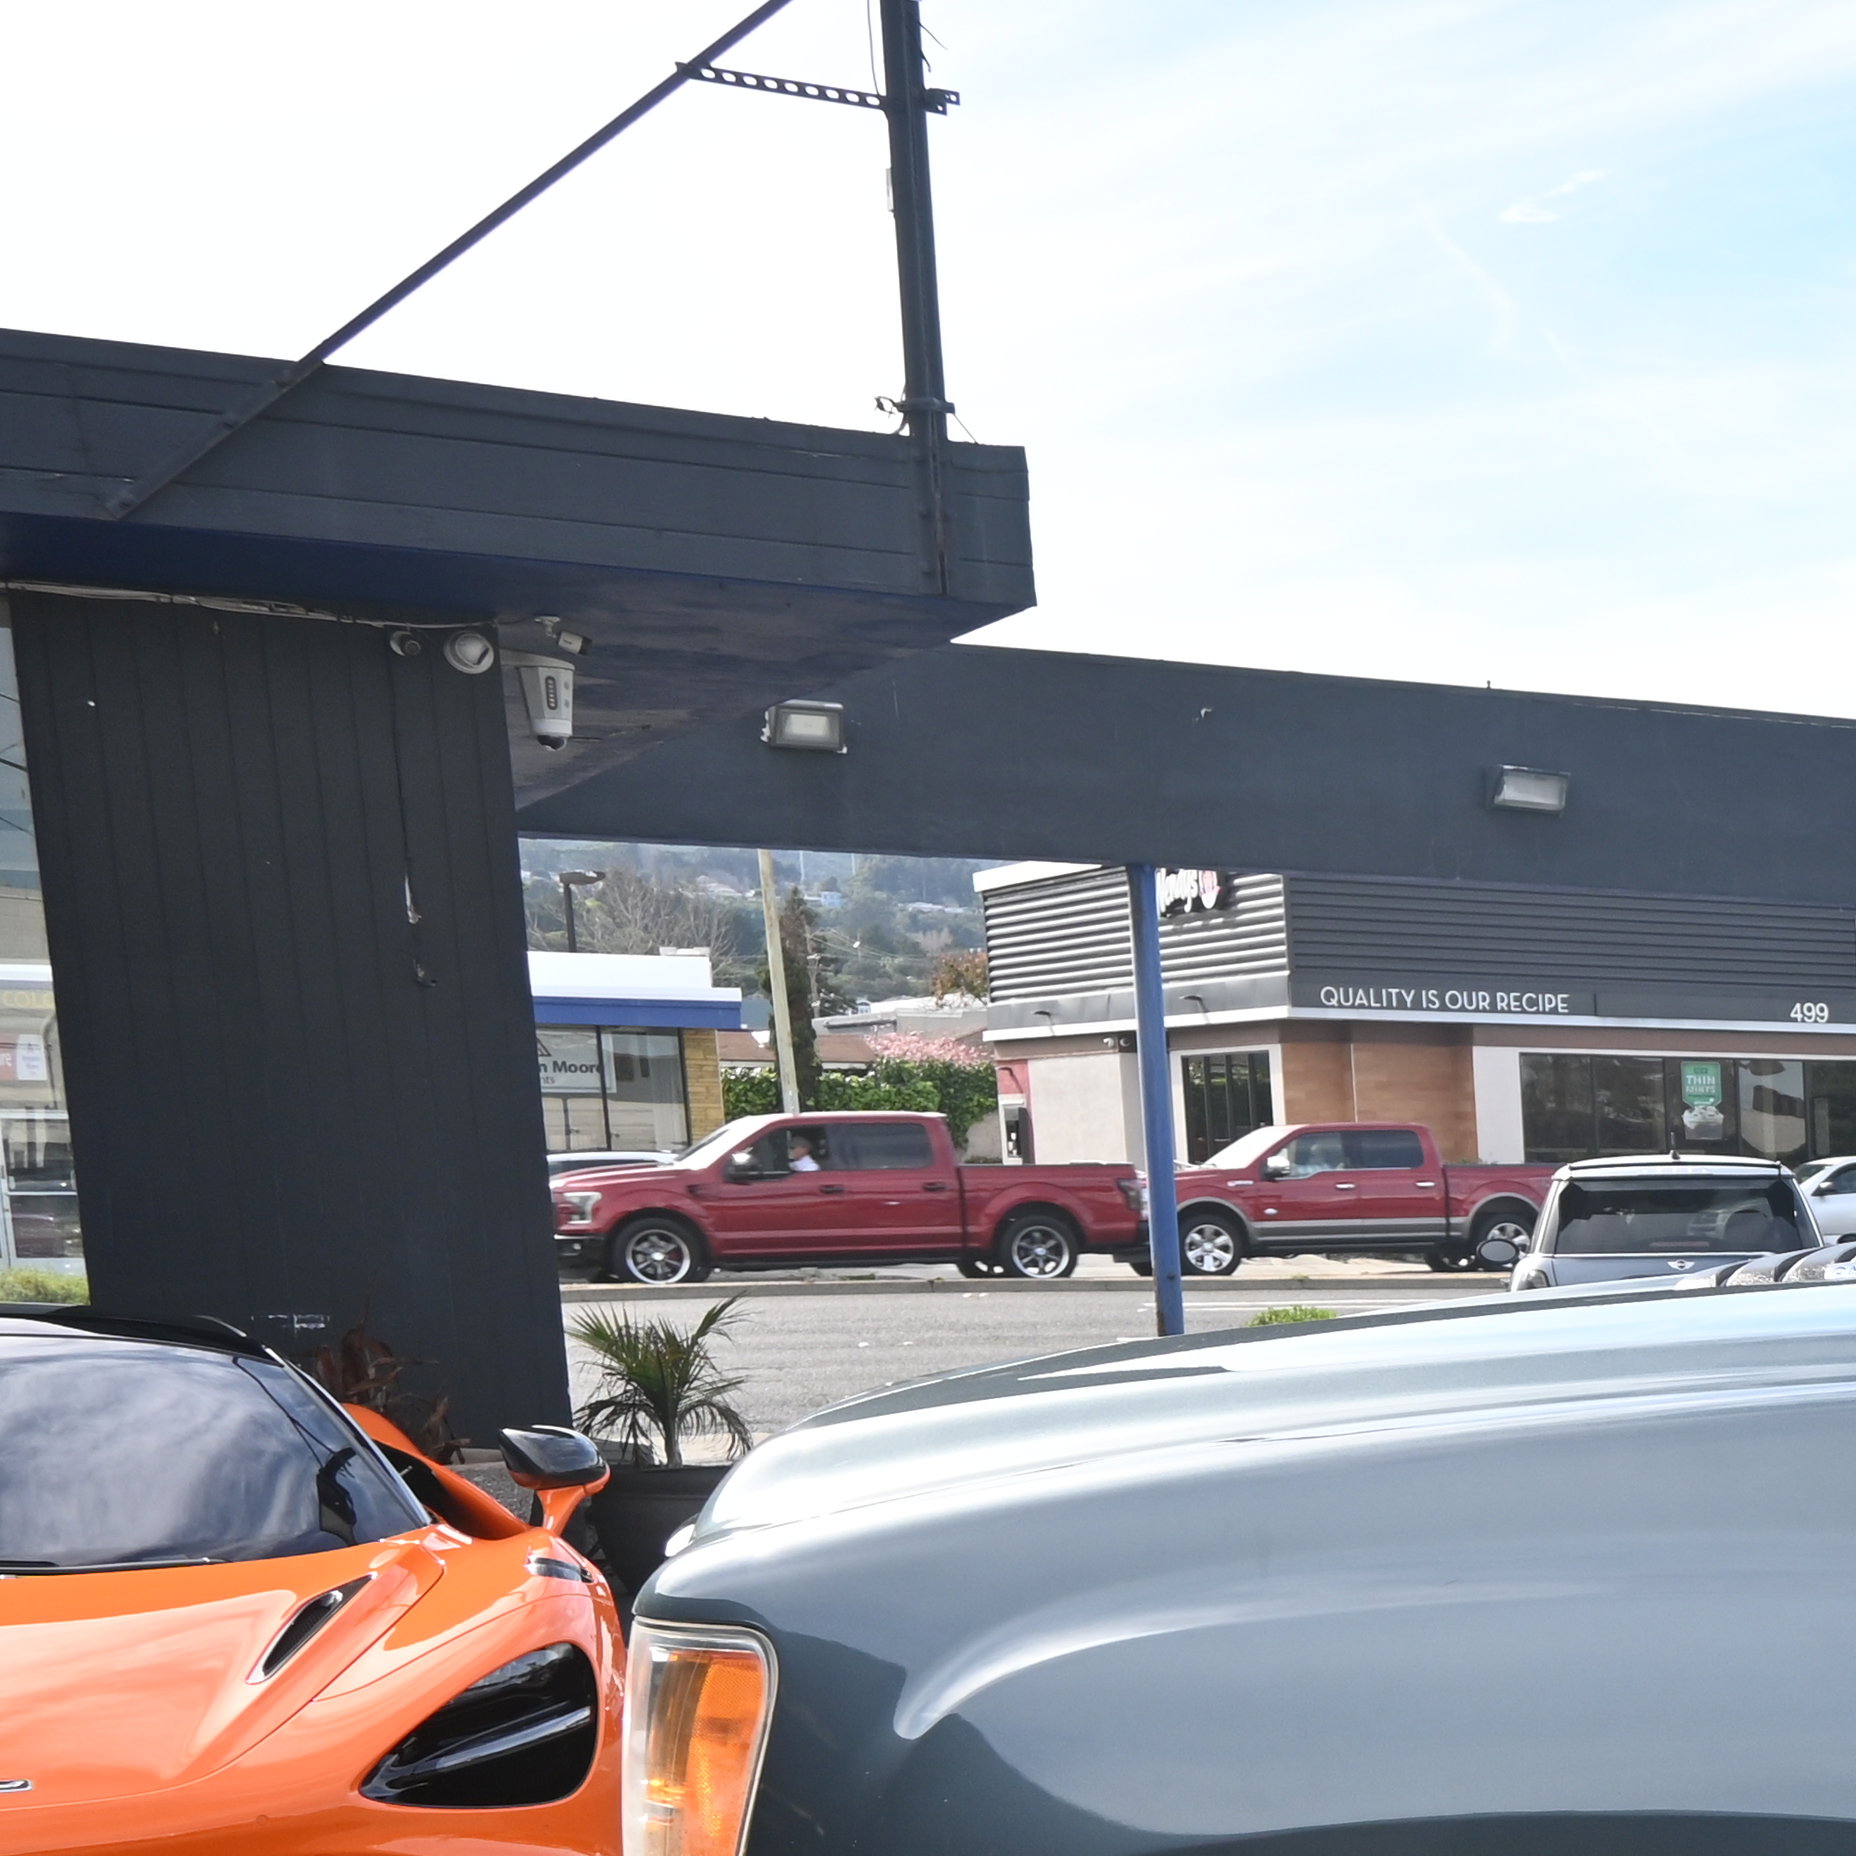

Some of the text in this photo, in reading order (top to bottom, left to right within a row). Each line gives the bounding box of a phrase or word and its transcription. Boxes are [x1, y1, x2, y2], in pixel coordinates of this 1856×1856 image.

[1320, 986, 1570, 1013] QUALITY IS OUR RECIPE
[1790, 1002, 1829, 1023] 499
[1685, 1074, 1716, 1086] THIN
